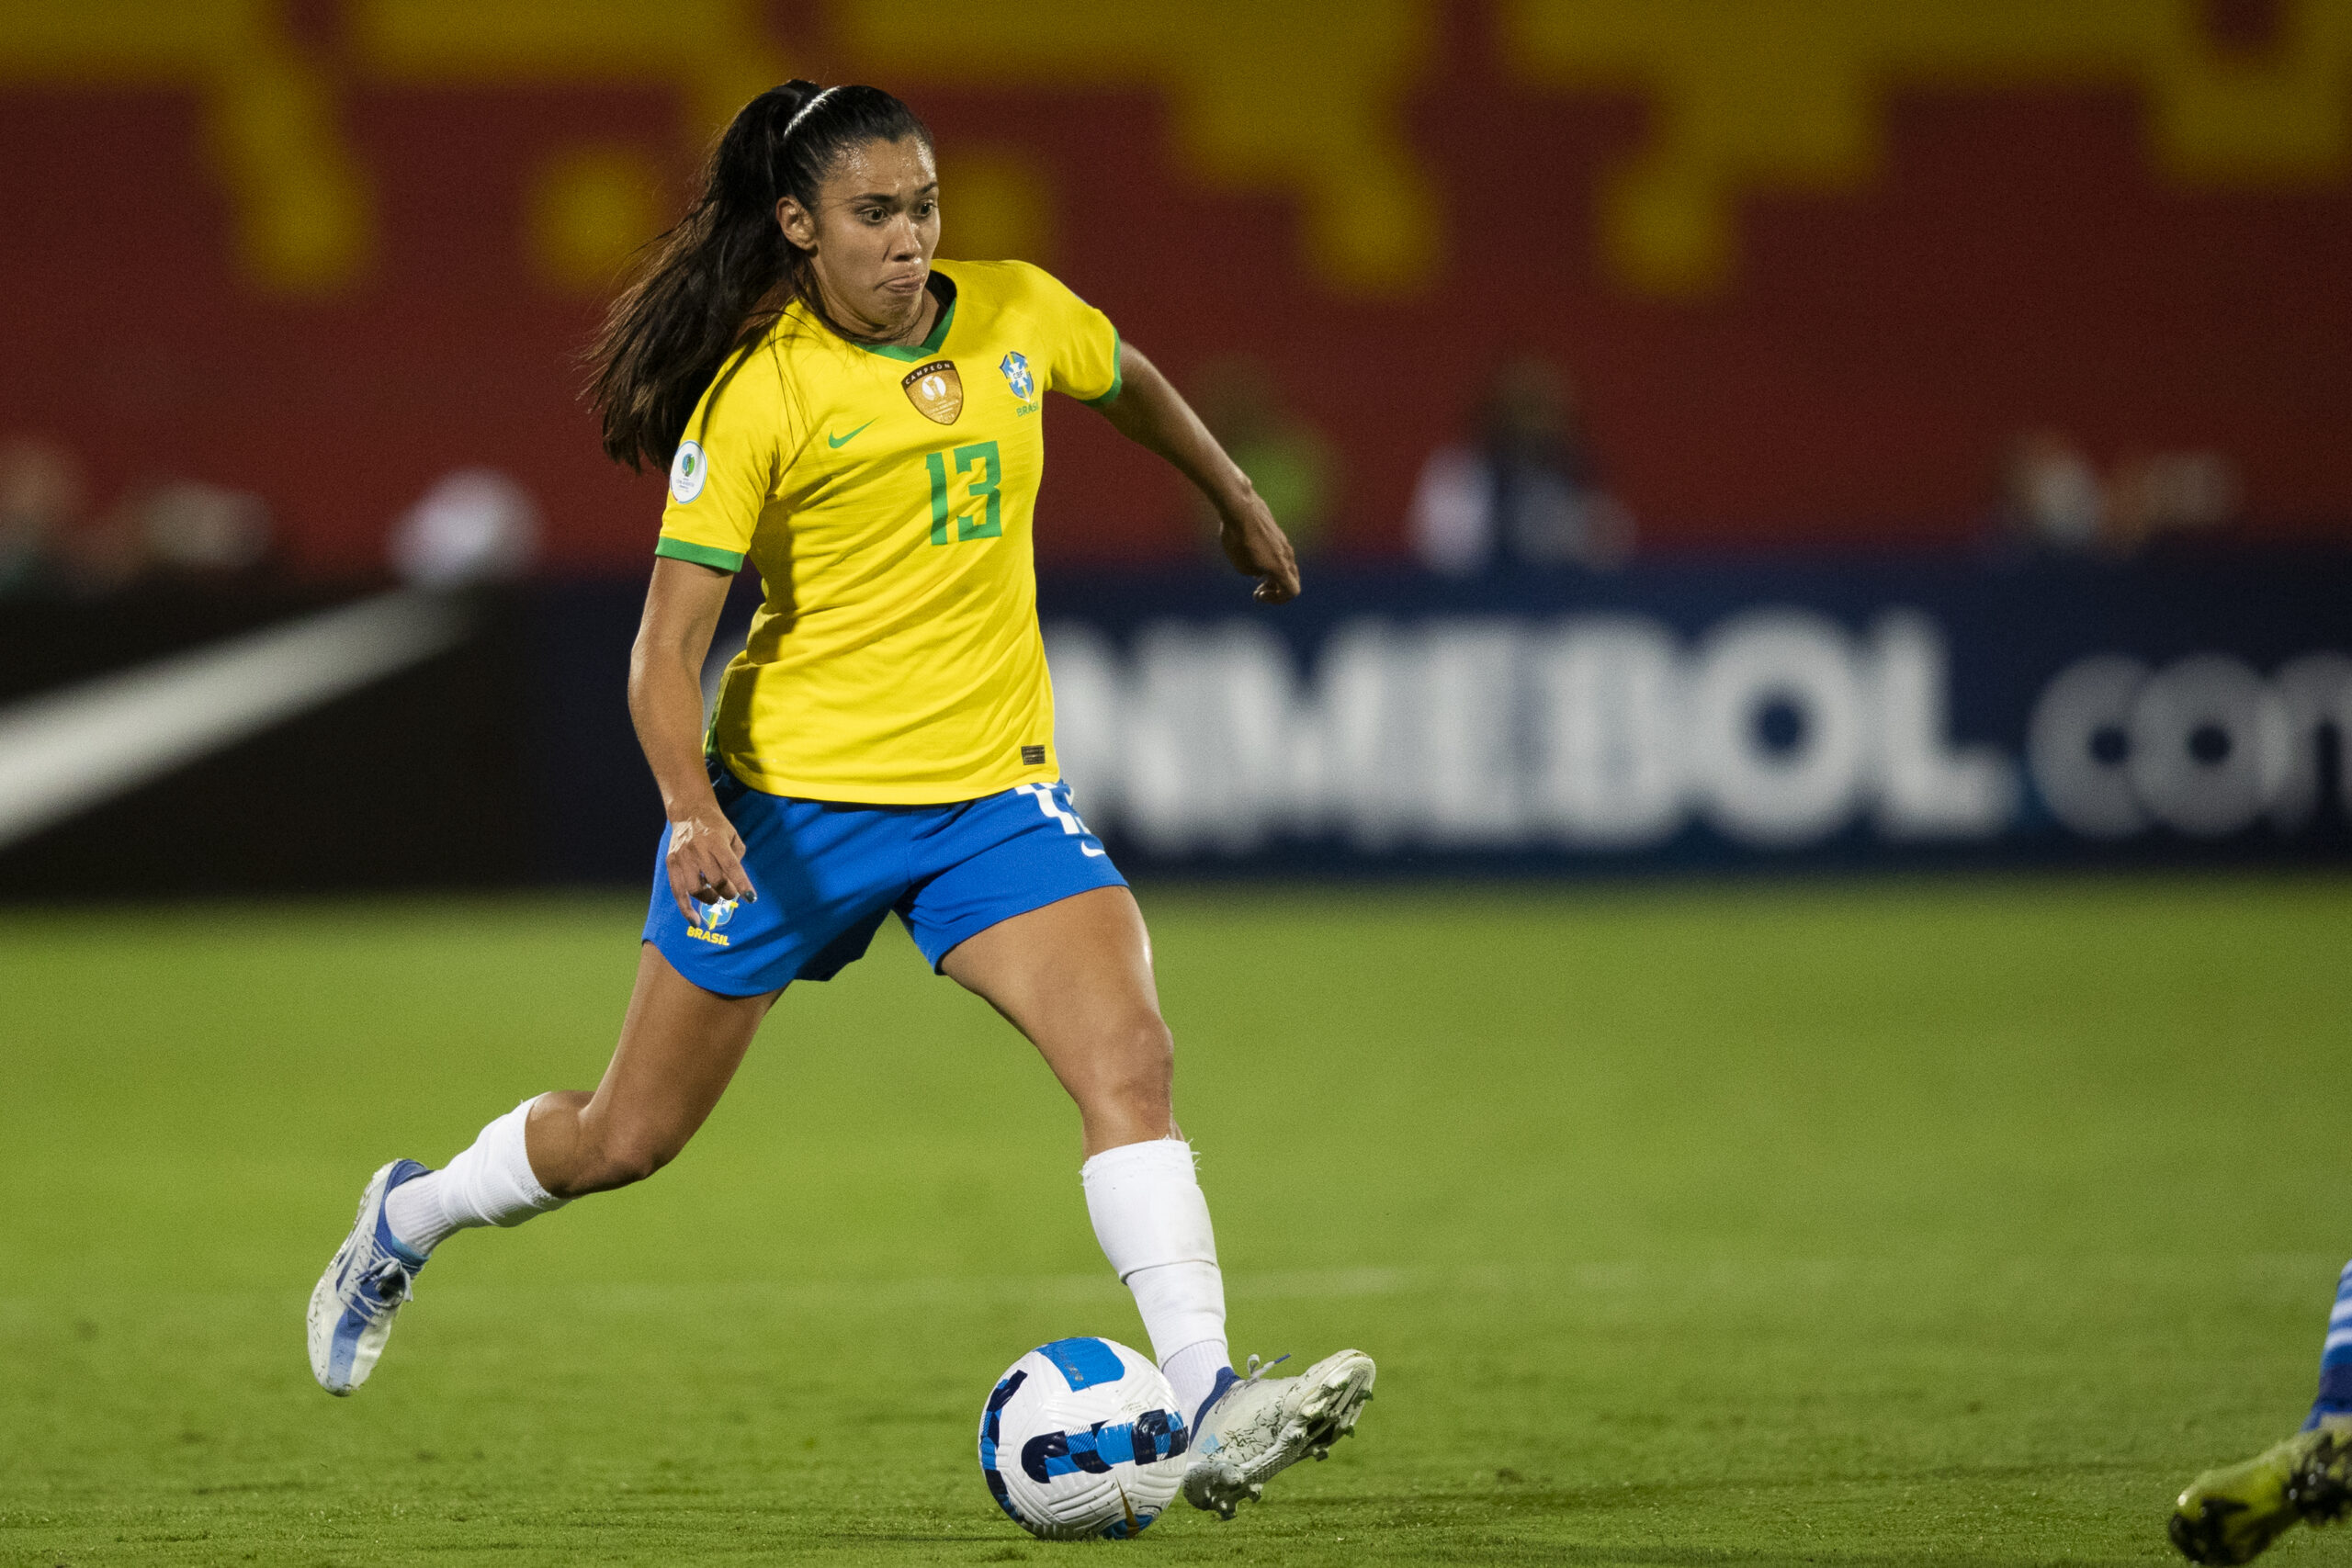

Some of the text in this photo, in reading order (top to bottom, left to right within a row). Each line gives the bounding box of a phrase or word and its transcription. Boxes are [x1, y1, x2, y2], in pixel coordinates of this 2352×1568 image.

[905, 363, 950, 385] CAMPEÓN
[1016, 401, 1039, 417] BRASI
[925, 440, 1002, 546] 13
[686, 925, 730, 946] BRASIL
